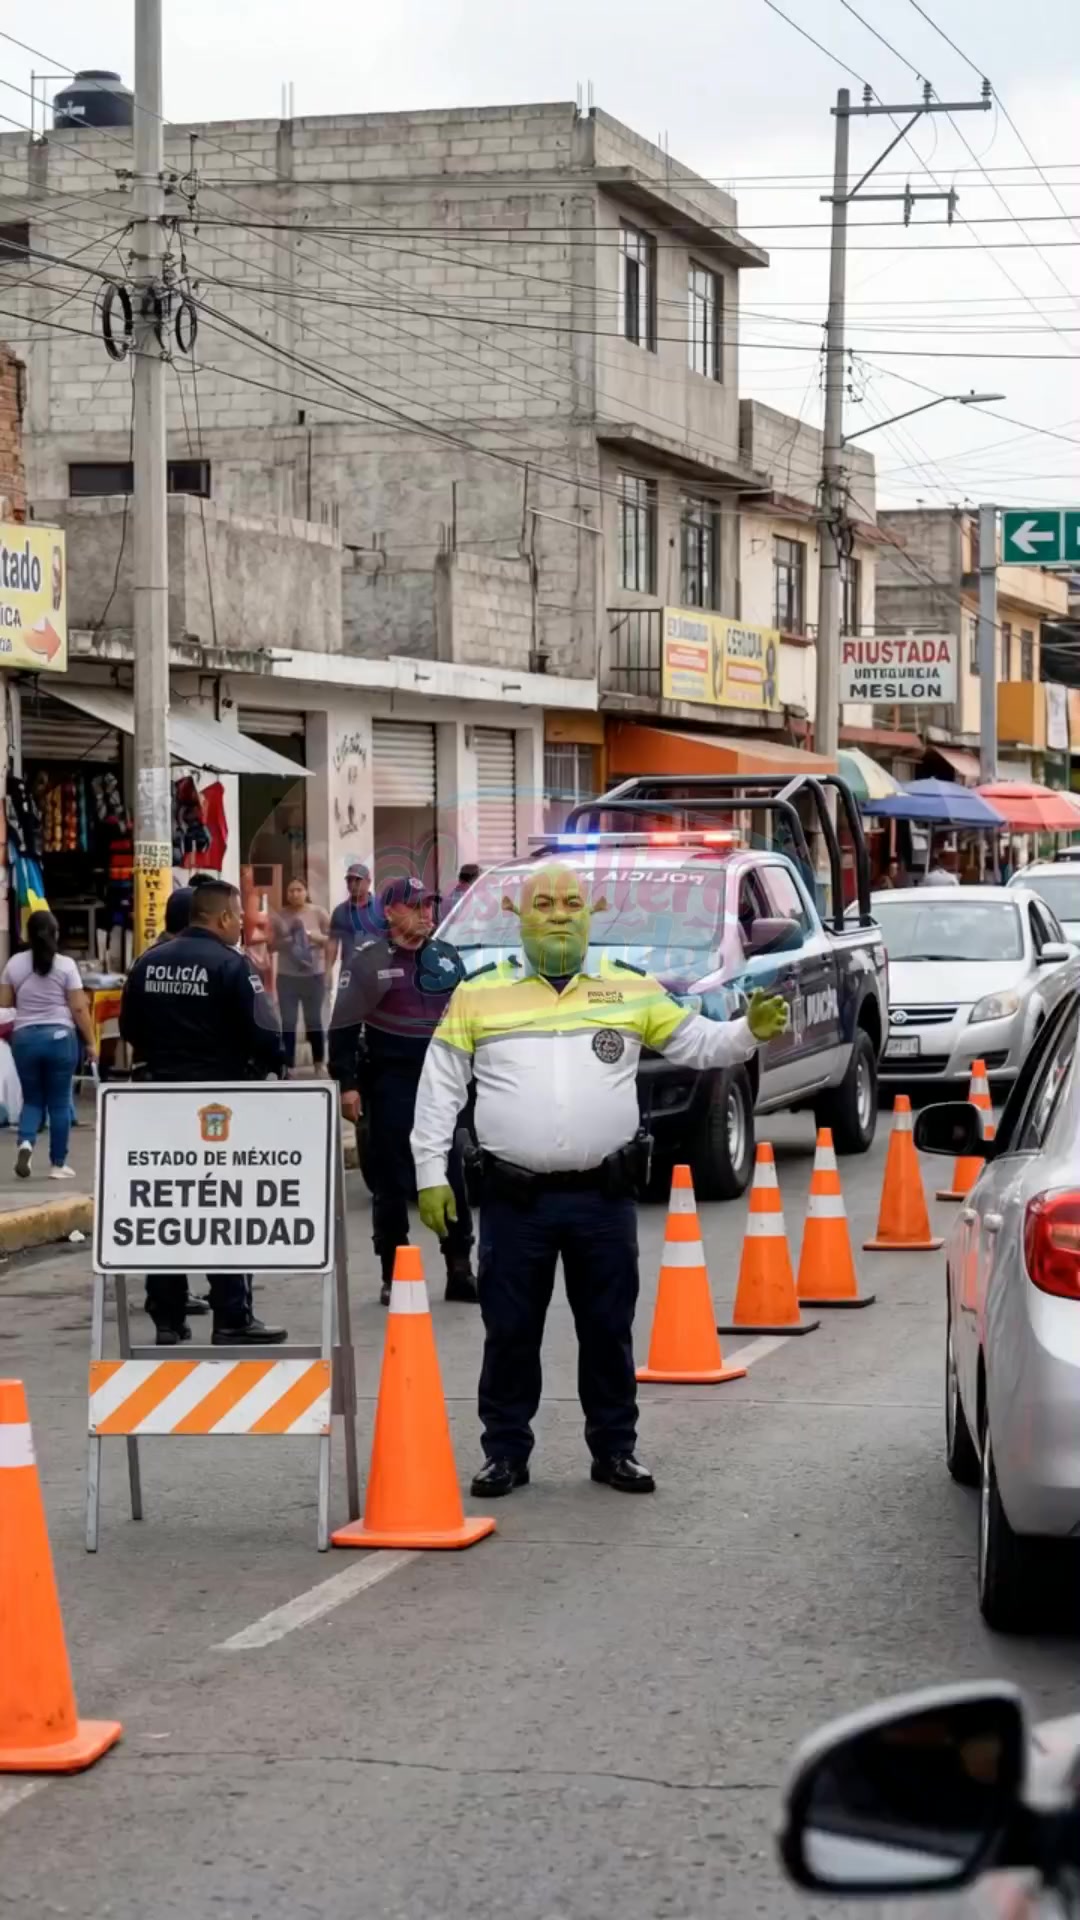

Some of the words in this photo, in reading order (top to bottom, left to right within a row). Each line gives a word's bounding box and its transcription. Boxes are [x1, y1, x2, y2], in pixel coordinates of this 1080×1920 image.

[0, 540, 41, 592] tado
[843, 641, 950, 664] RIUSTADA
[849, 683, 941, 698] MESLON
[128, 1150, 197, 1166] ESTADO
[203, 1150, 226, 1166] DE
[232, 1146, 302, 1166] MÉXICO
[129, 1172, 243, 1208] RETÉN
[256, 1179, 301, 1208] DE
[113, 1217, 315, 1246] SEGURIDAD
